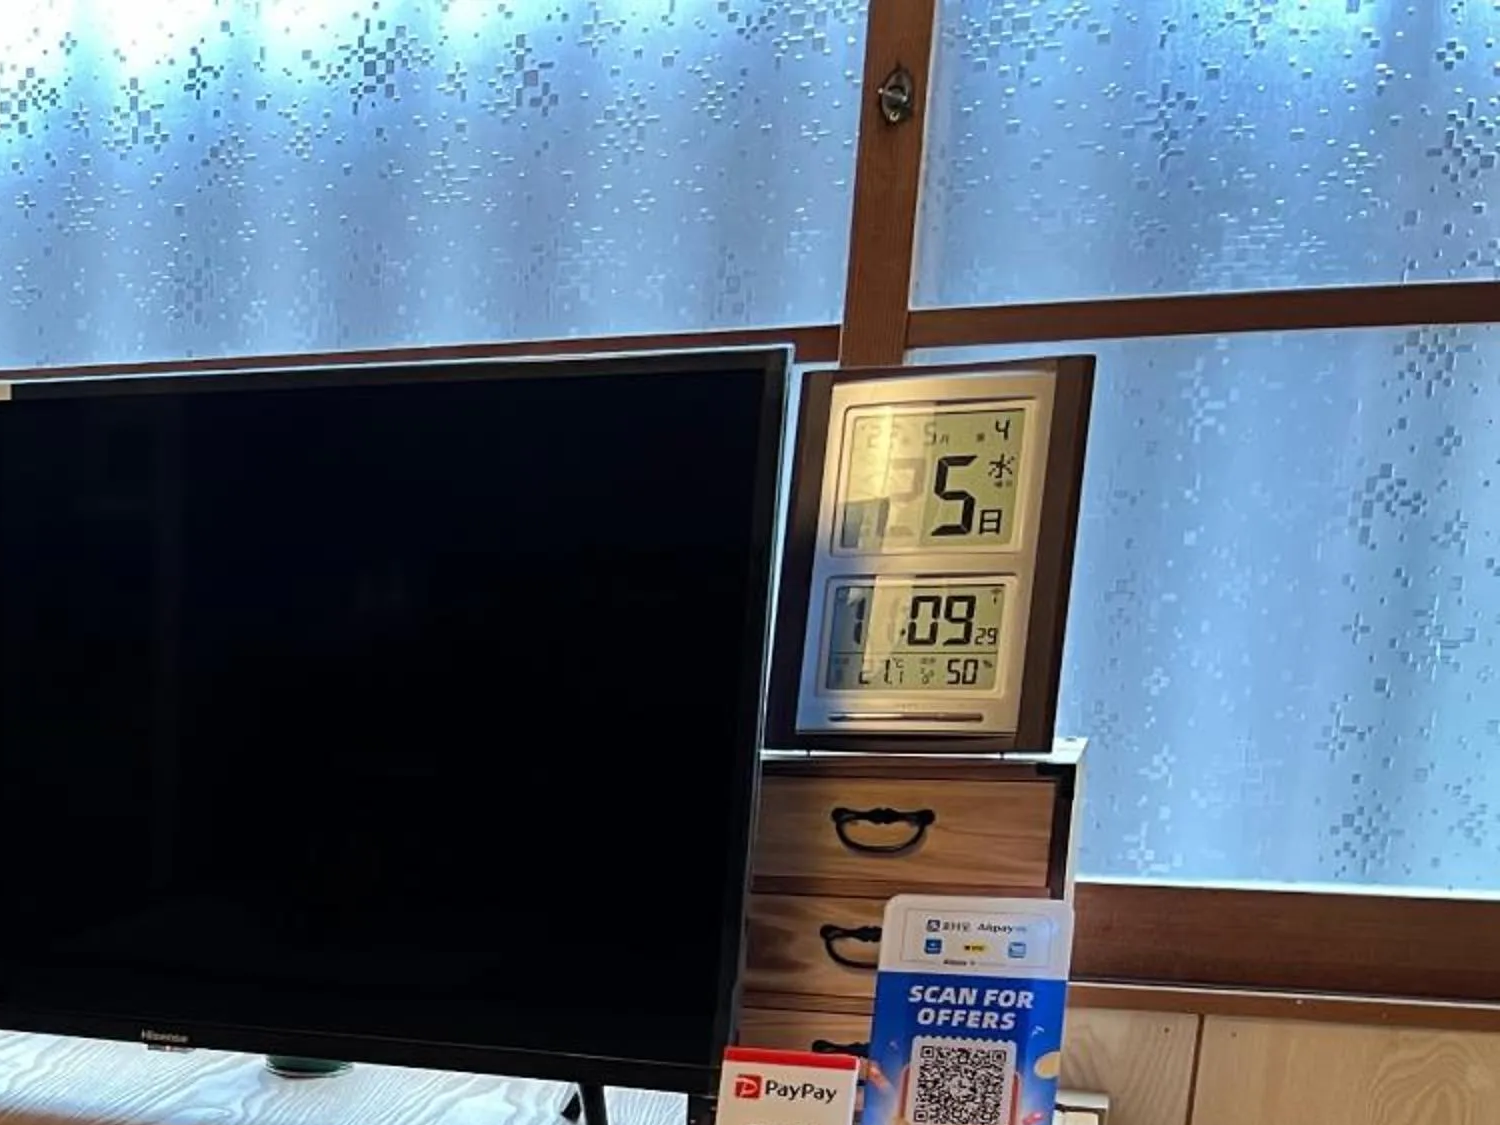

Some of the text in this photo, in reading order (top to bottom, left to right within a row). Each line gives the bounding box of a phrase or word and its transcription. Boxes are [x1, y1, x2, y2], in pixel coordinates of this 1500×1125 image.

[995, 419, 1010, 440] 4
[975, 627, 998, 645] 29
[947, 659, 978, 685] 50
[908, 985, 1035, 1009] SCAN FOR
[917, 1007, 1016, 1030] OFFERS
[765, 1079, 838, 1104] PayPay
